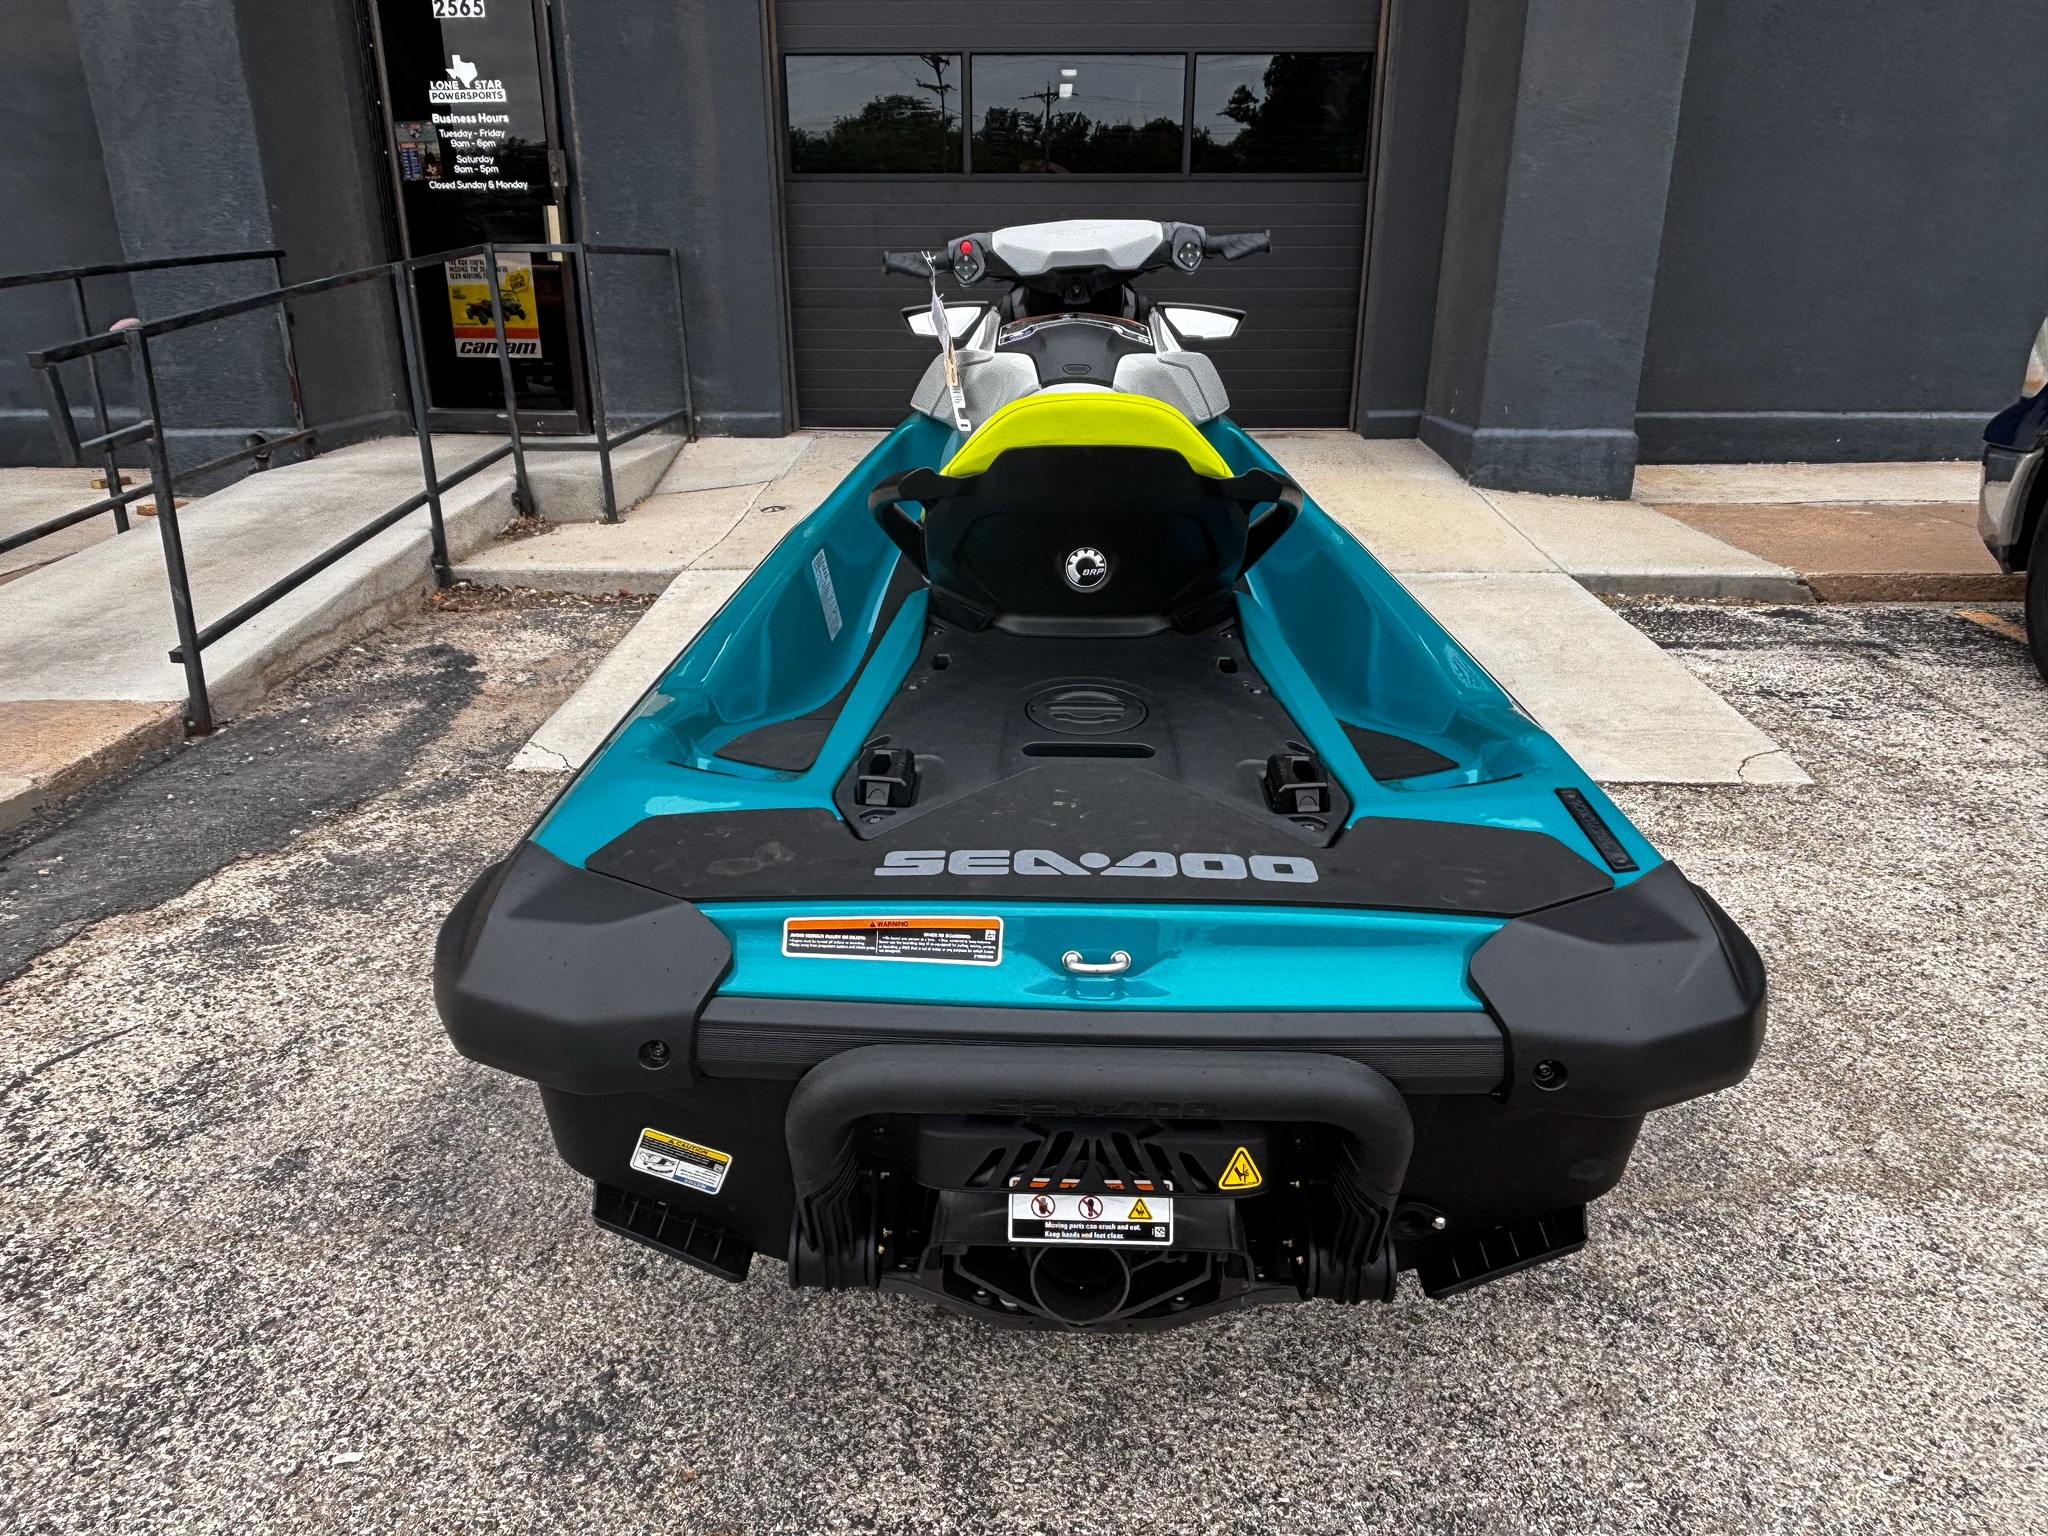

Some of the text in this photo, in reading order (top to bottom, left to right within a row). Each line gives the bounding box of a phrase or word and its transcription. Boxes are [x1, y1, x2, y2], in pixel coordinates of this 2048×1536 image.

[434, 0, 483, 16] 2565
[430, 80, 502, 90] LONE STAR
[432, 91, 503, 100] POWERSPORTS
[431, 112, 509, 123] Business Hours
[439, 129, 473, 139] Tuesday
[480, 129, 505, 139] Friday
[451, 139, 470, 148] 9am
[477, 139, 496, 151] 6pm
[456, 155, 494, 165] Saturday
[454, 165, 473, 173] 9am
[480, 165, 499, 175] 5pm
[429, 181, 528, 191] Closed Sunday & Monday
[1082, 567, 1104, 576] BRP
[1044, 1221, 1068, 1230] Moving
